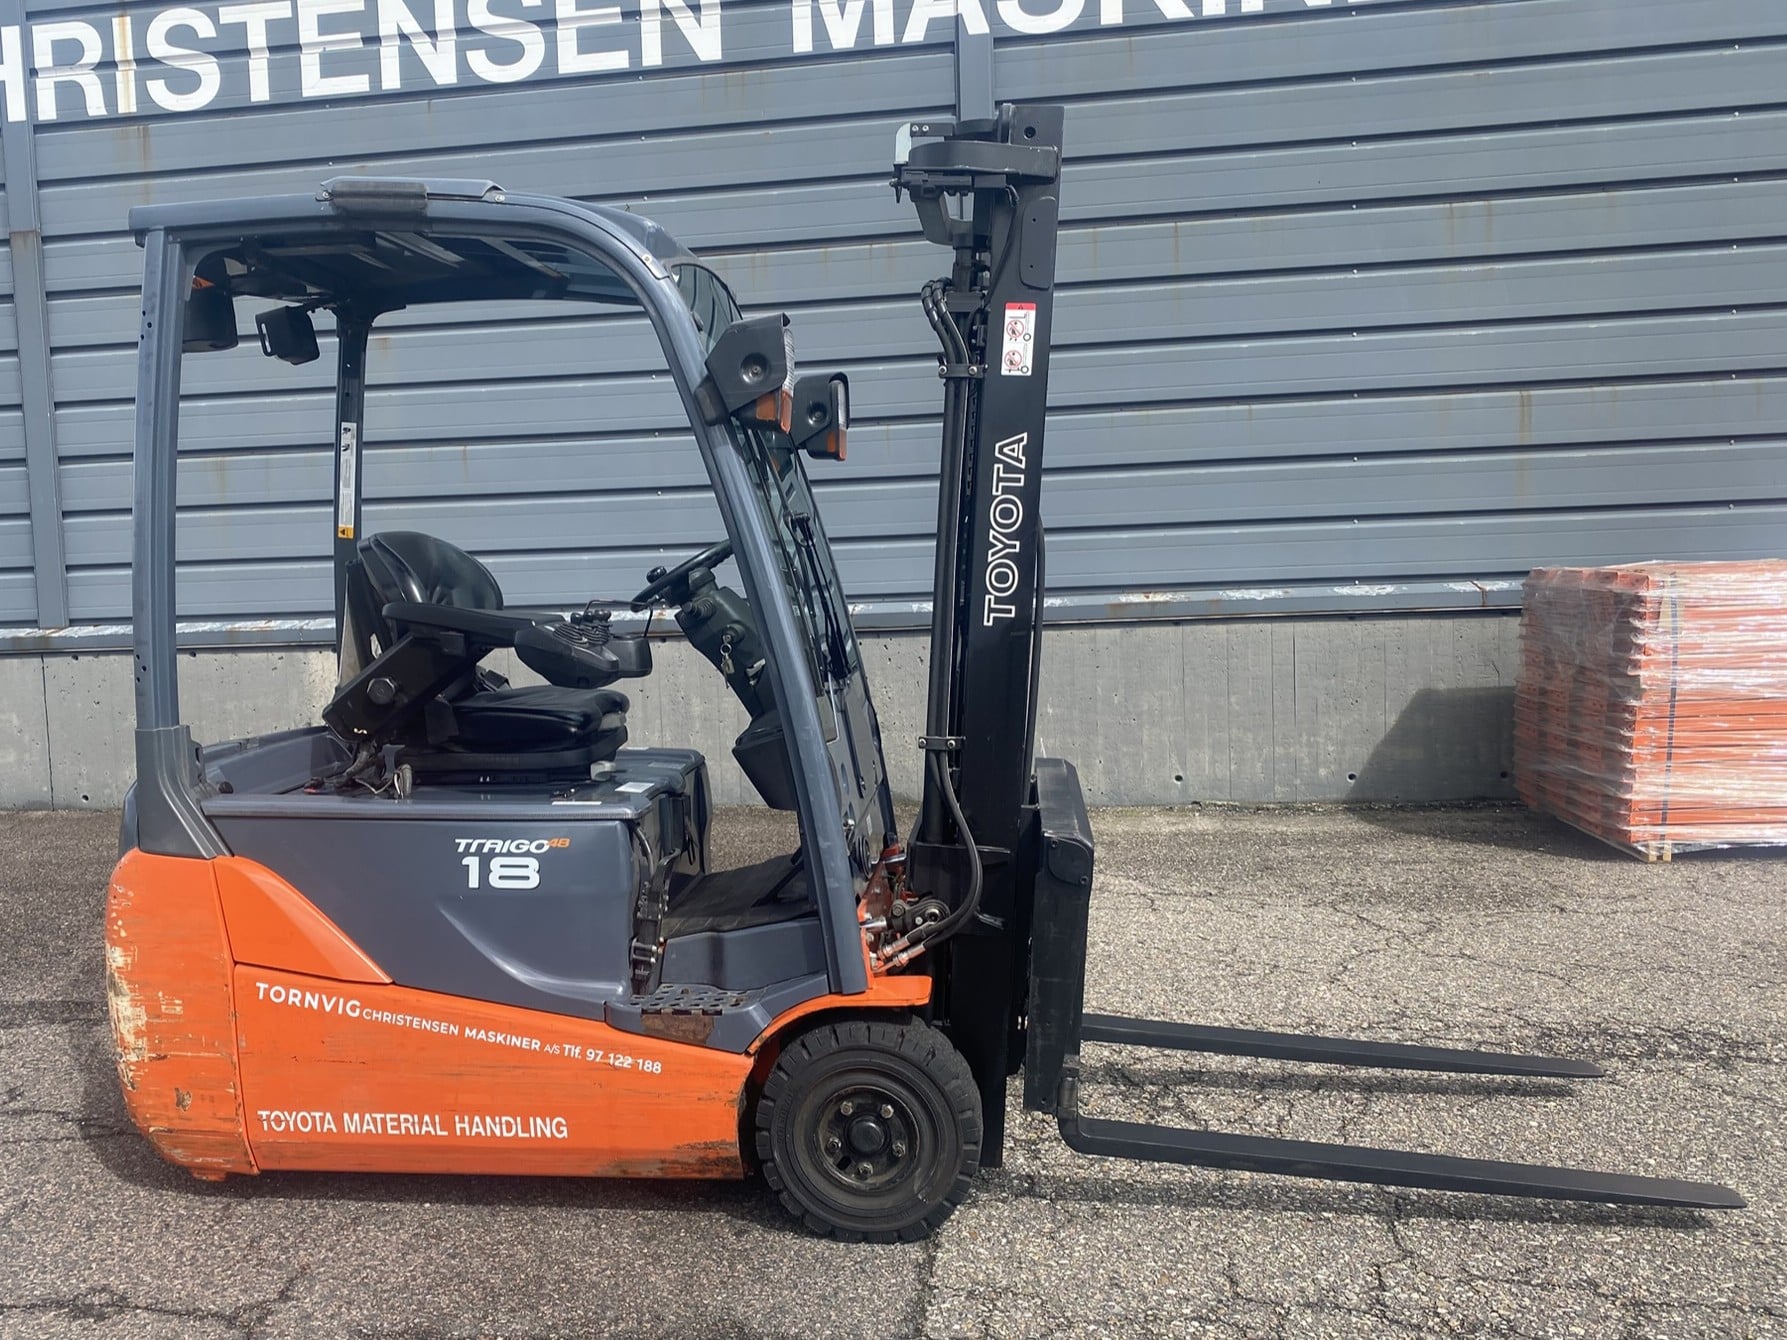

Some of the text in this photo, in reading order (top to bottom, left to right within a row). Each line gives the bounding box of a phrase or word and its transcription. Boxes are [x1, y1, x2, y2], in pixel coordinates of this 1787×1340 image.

[983, 432, 1028, 627] TOYOTA
[461, 856, 540, 889] 18
[255, 982, 361, 1018] TORNVIG
[362, 1008, 459, 1036] CHRISTENSEN
[464, 1024, 541, 1051] MASKINER
[543, 1043, 561, 1055] A/S
[585, 1050, 604, 1063] 97
[607, 1052, 633, 1069] 122
[636, 1058, 663, 1074] 188
[257, 1110, 569, 1139] TOYOTA MATERIAL HANDLING
